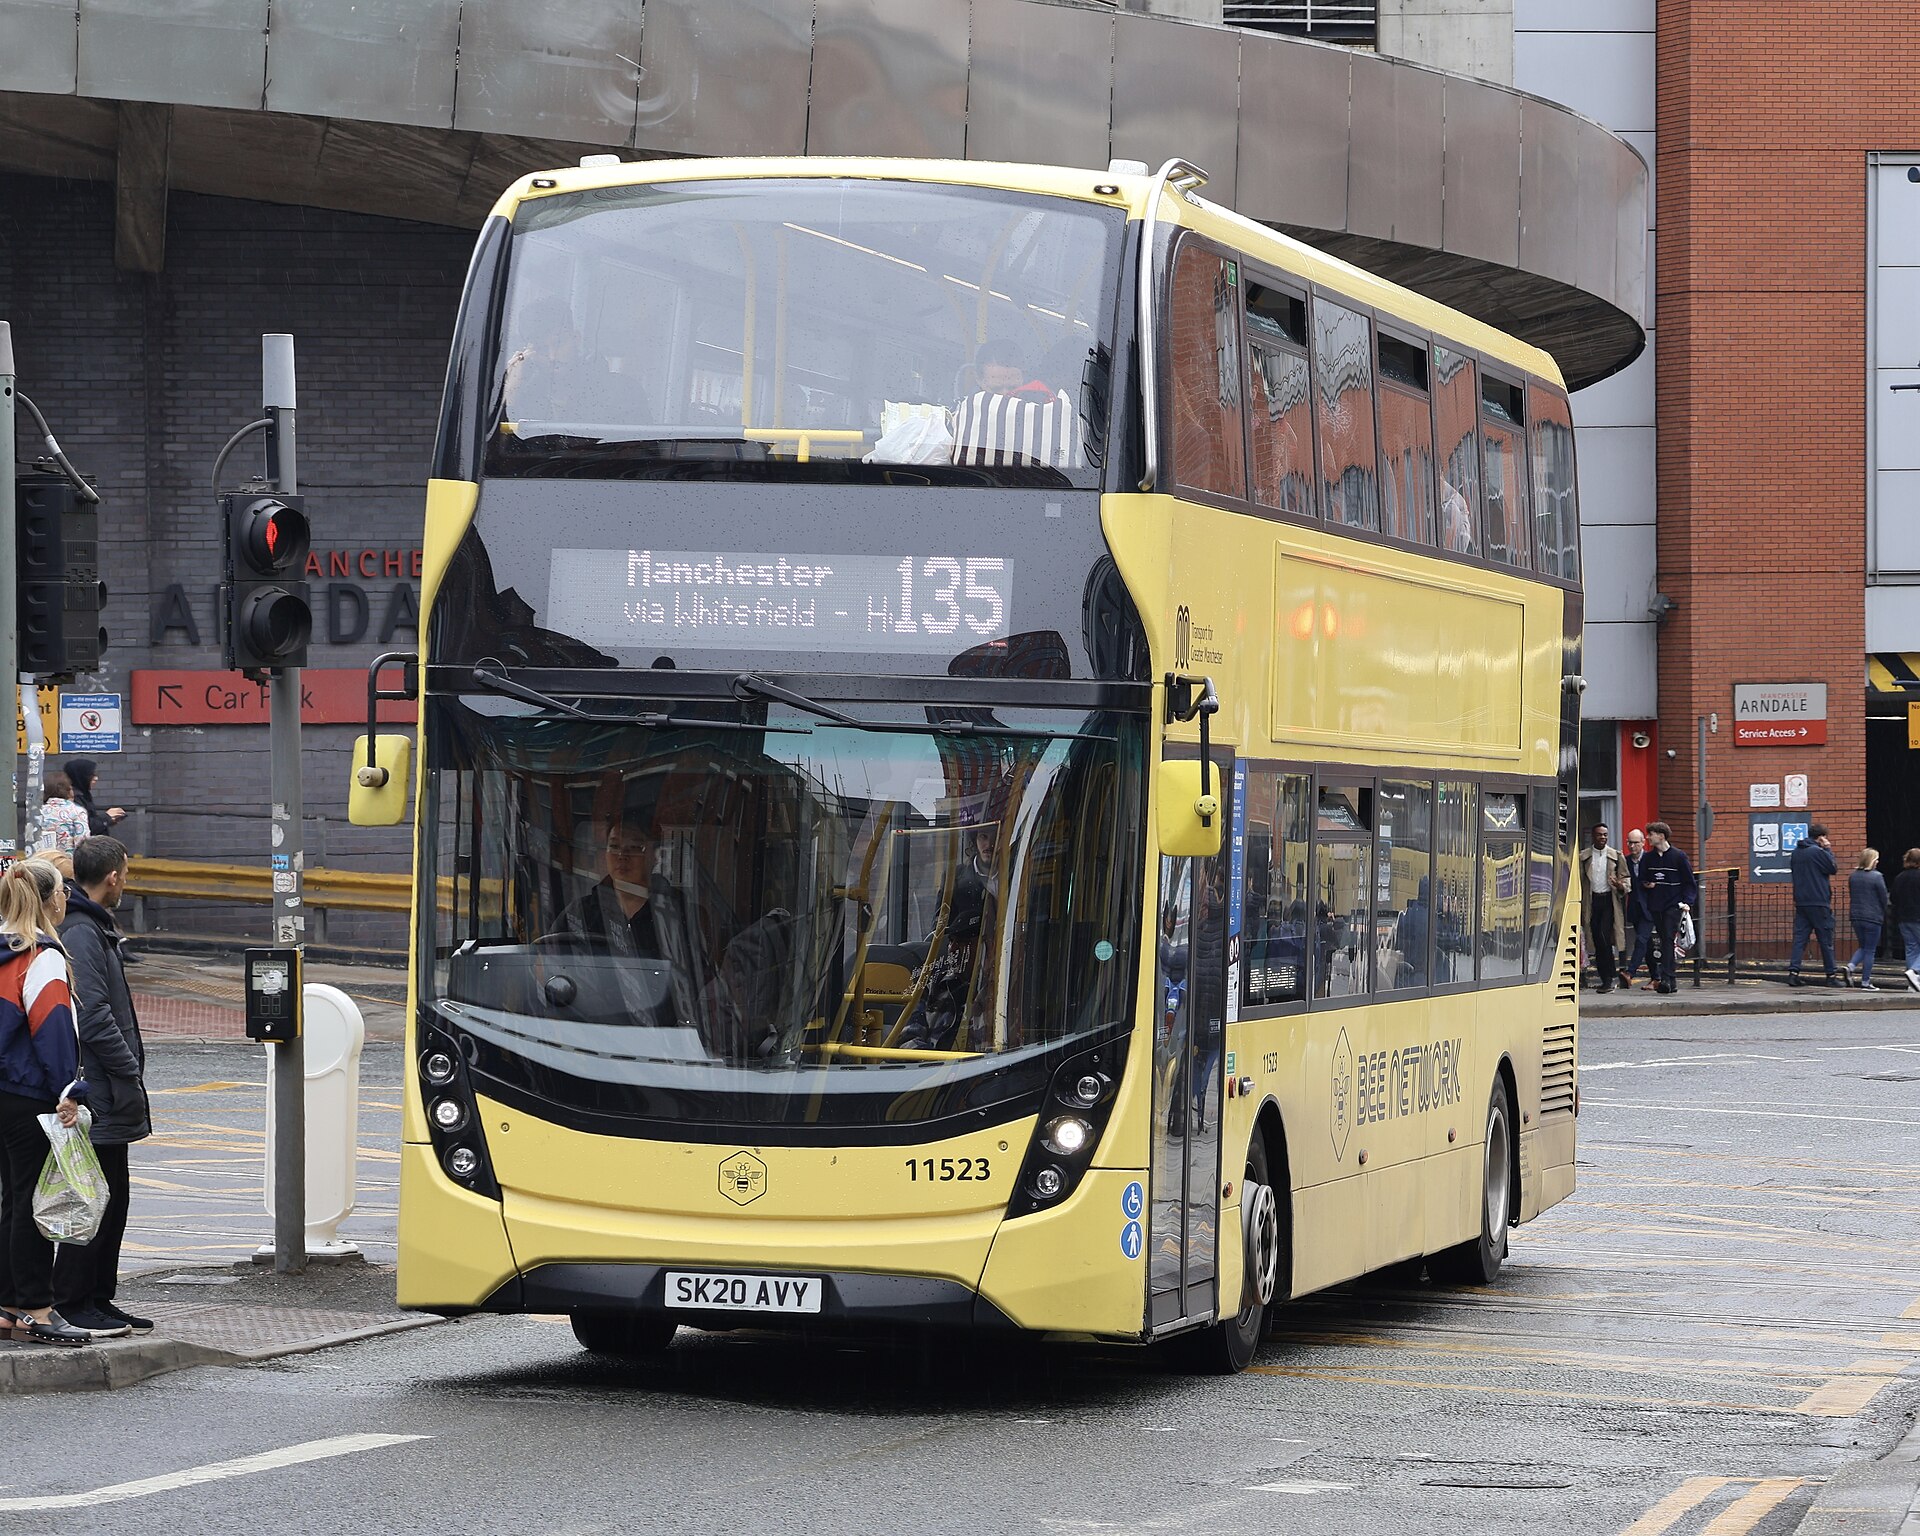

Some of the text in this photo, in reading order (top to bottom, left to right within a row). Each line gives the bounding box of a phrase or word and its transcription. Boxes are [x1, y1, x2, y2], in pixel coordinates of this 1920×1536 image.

[627, 550, 1005, 635] Manchester 135
[624, 598, 664, 626] via
[674, 592, 815, 628] Whitefield
[205, 684, 314, 709] Car Pk
[1740, 699, 1808, 713] ARNDALE
[1739, 727, 1796, 738] Service Access
[1262, 1051, 1278, 1075] 11523
[1357, 1037, 1462, 1126] BEE NETWORK
[905, 1158, 991, 1182] 11523
[677, 1277, 809, 1307] SK20 AVY
